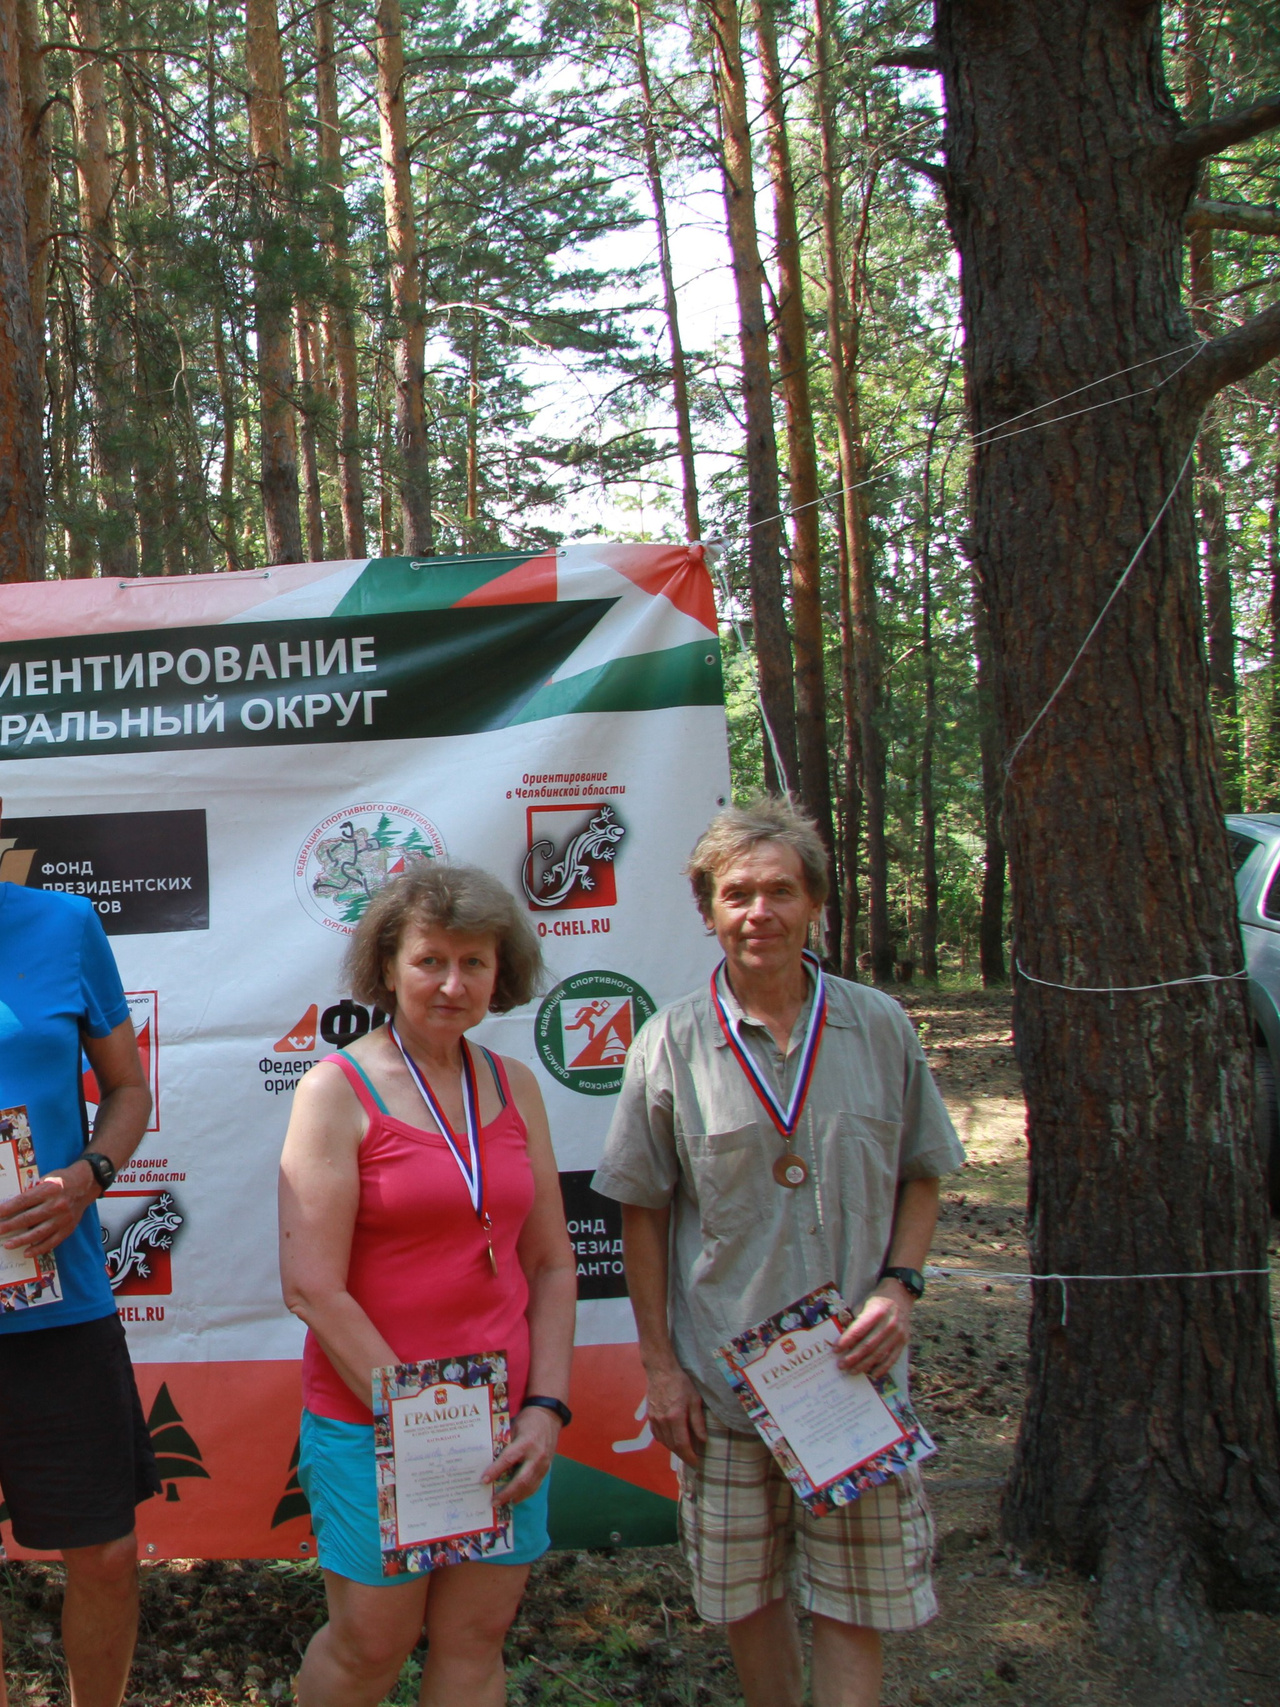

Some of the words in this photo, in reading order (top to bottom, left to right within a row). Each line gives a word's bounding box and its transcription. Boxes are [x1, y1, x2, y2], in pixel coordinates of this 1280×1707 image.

[240, 689, 388, 731] ОКРУГ
[522, 772, 608, 787] Ориентирование
[506, 790, 512, 799] в
[515, 785, 580, 799] Челябинской
[582, 784, 626, 796] области
[296, 828, 323, 877] ФЕДЕРАЦИЯ
[321, 804, 384, 830] СПОРТИВНОГО
[385, 804, 444, 857] ОРИЕНТИРОВАНИЯ
[41, 860, 94, 876] ФОНД
[42, 877, 192, 895] ПРЕЗИДЕНТСКИХ
[322, 917, 356, 935] КУРГАН
[537, 918, 610, 938] O-CHEL.RU
[540, 989, 567, 1037] ФЕДЕРАЦИЯ
[570, 976, 634, 993] СПОРТИВНОГО
[259, 1057, 321, 1076] Федер
[542, 1044, 570, 1079] ОБЛАСТИ
[578, 1077, 623, 1090] МЕНСКОЙ
[140, 1170, 186, 1183] области
[566, 1218, 607, 1235] ОНД
[575, 1261, 624, 1276] АНТО
[116, 1306, 165, 1322] HEL.RU
[761, 1337, 834, 1385] ГРАМОТА
[403, 1403, 480, 1427] ГРАМОТА
